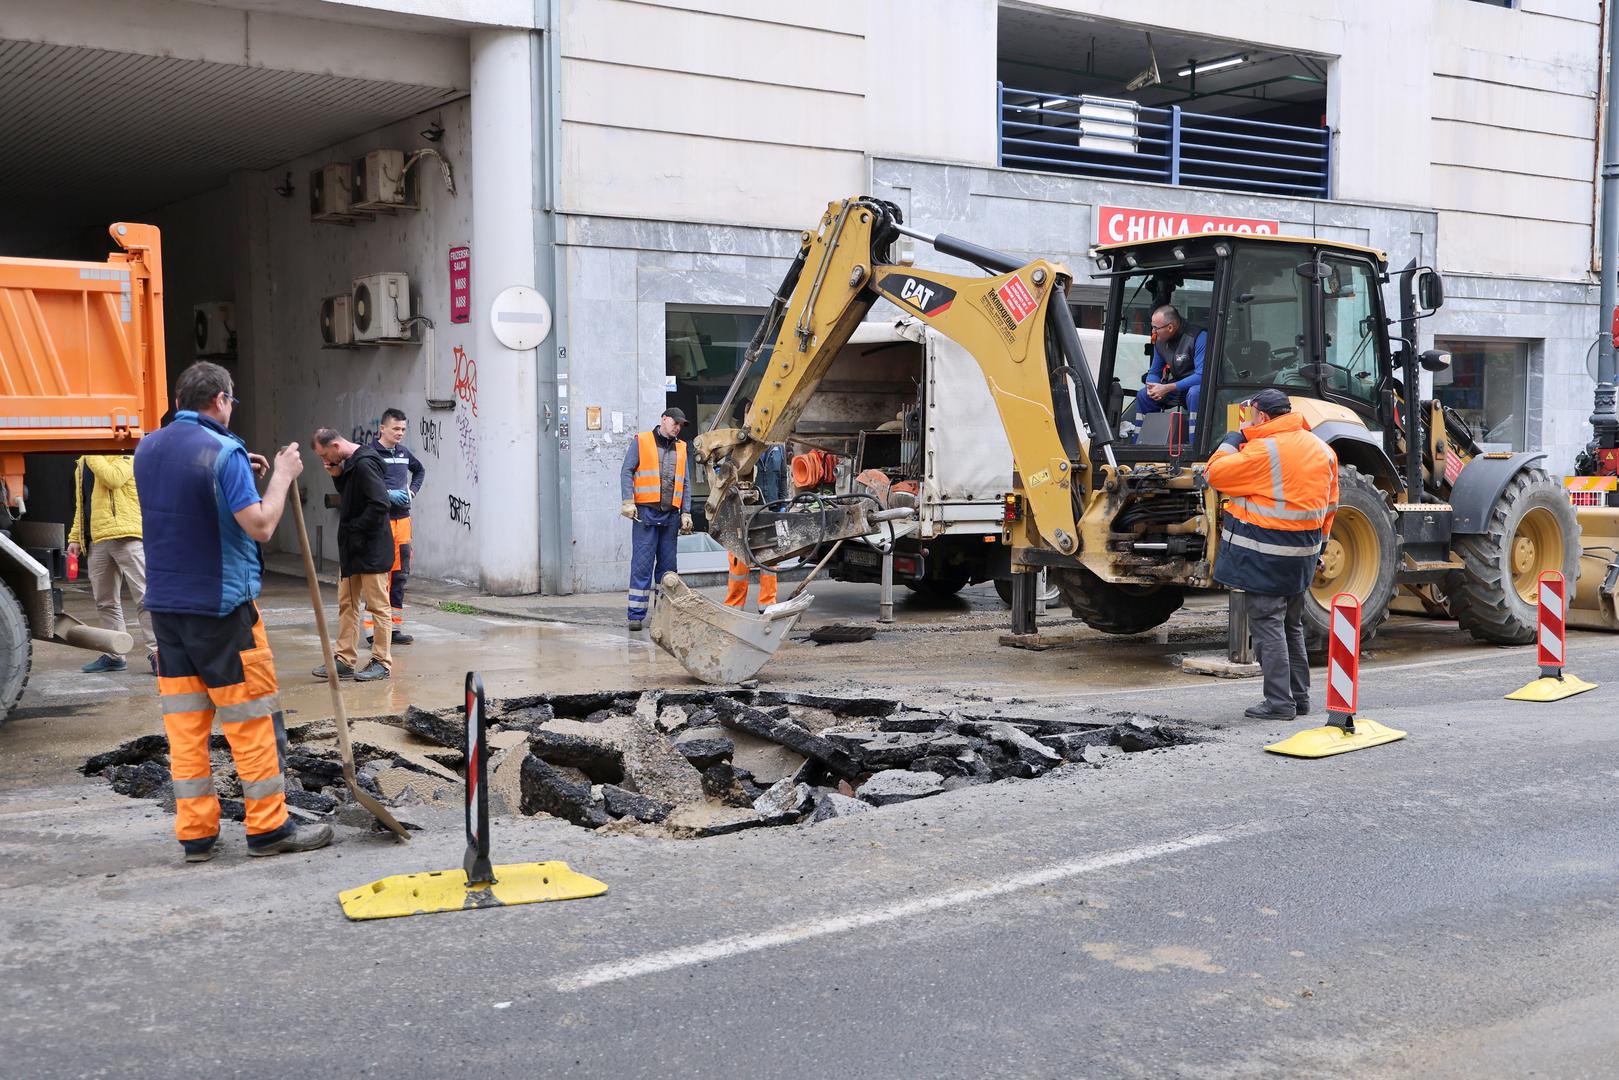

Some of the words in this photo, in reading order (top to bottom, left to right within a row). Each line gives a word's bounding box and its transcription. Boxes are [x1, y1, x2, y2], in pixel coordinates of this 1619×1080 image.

[1108, 213, 1190, 242] CHINA
[454, 260, 467, 271] SALON
[901, 278, 935, 310] CAT
